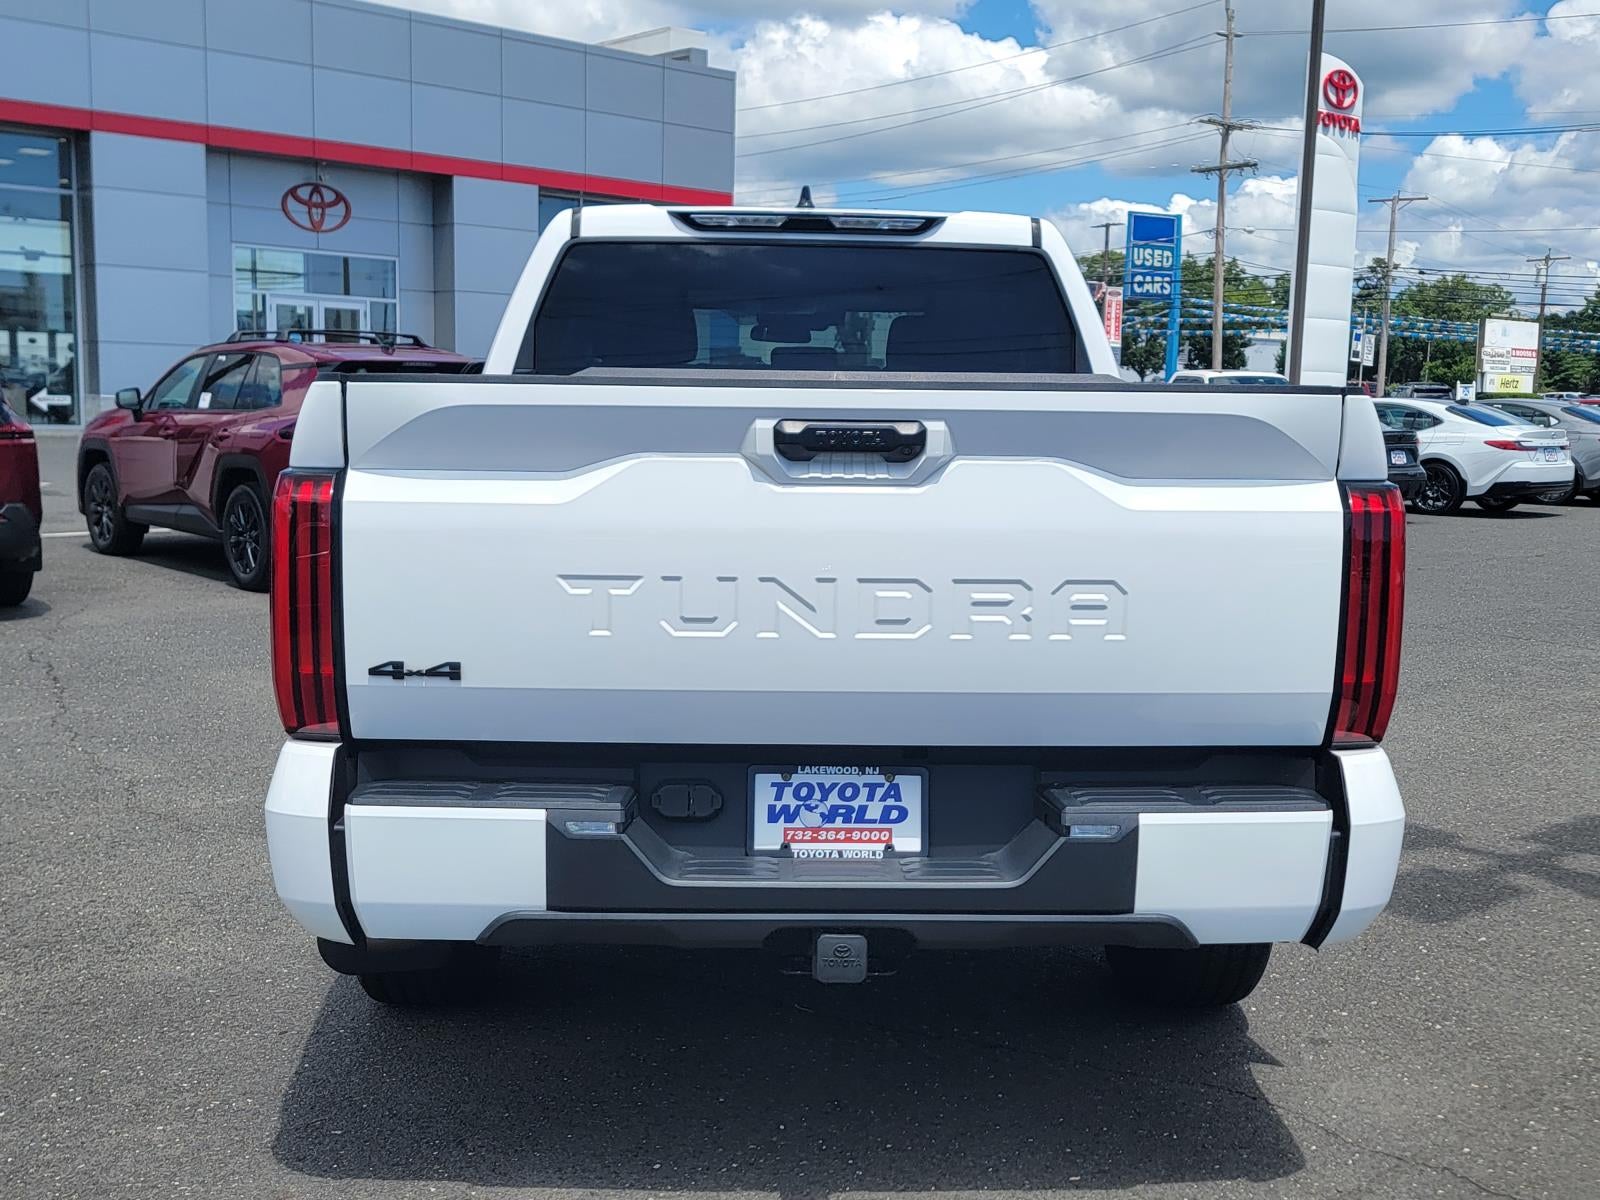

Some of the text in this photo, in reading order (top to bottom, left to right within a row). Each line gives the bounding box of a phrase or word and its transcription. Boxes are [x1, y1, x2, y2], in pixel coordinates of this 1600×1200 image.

[1316, 111, 1360, 133] TOYOTA
[1133, 247, 1173, 268] USED
[1133, 274, 1171, 295] CARS
[1500, 378, 1519, 389] Hertz
[815, 430, 886, 445] TOYOTA
[555, 573, 1128, 641] TUNDRA
[797, 765, 880, 775] LAKEWOOD, NJ
[770, 781, 903, 802] TOYOTA
[767, 803, 909, 825] WORLD
[786, 830, 890, 841] 732-364-9000
[792, 849, 884, 860] TOYOTA WORLD
[821, 957, 863, 968] TOYOTA
